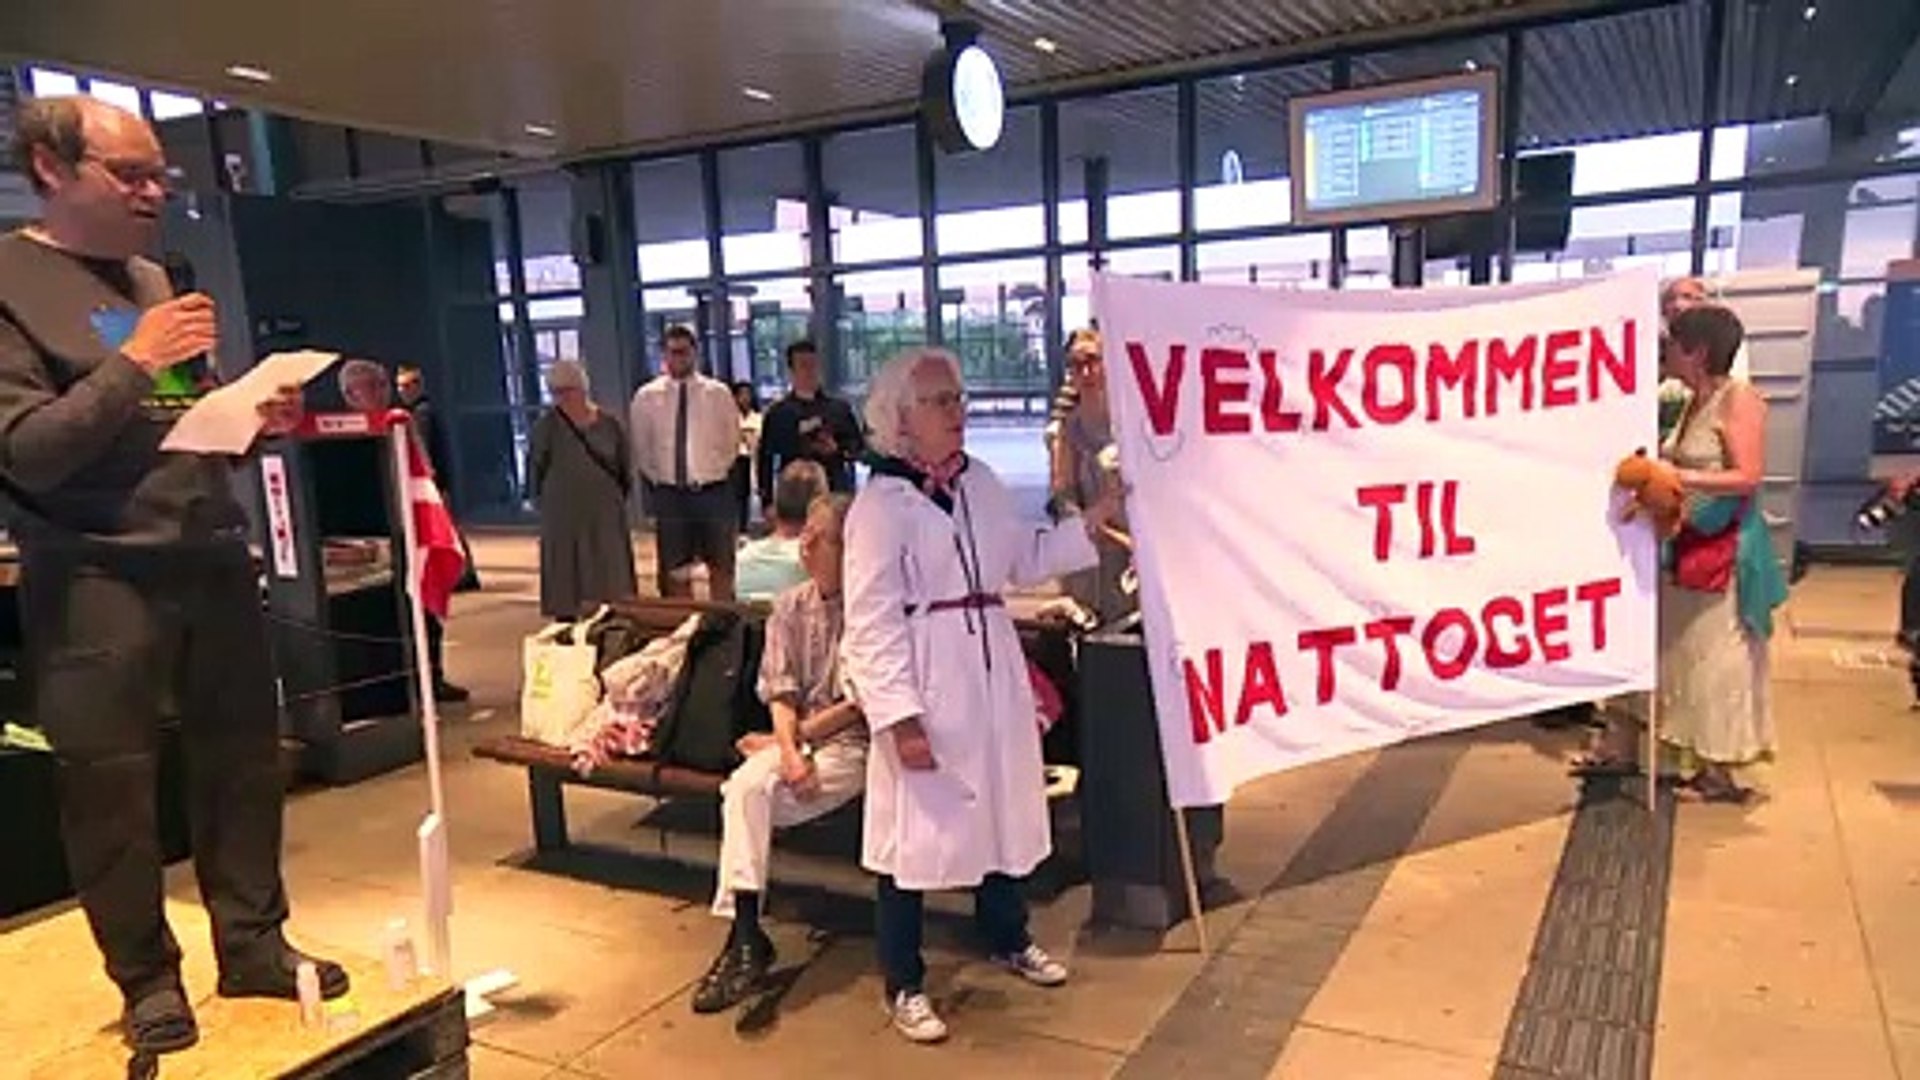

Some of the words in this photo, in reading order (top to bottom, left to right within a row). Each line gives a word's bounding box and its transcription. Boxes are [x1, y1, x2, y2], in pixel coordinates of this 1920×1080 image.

[1126, 319, 1637, 436] VELKOMMEN
[1356, 480, 1476, 562] TIL
[1182, 578, 1622, 745] NATTOGET
